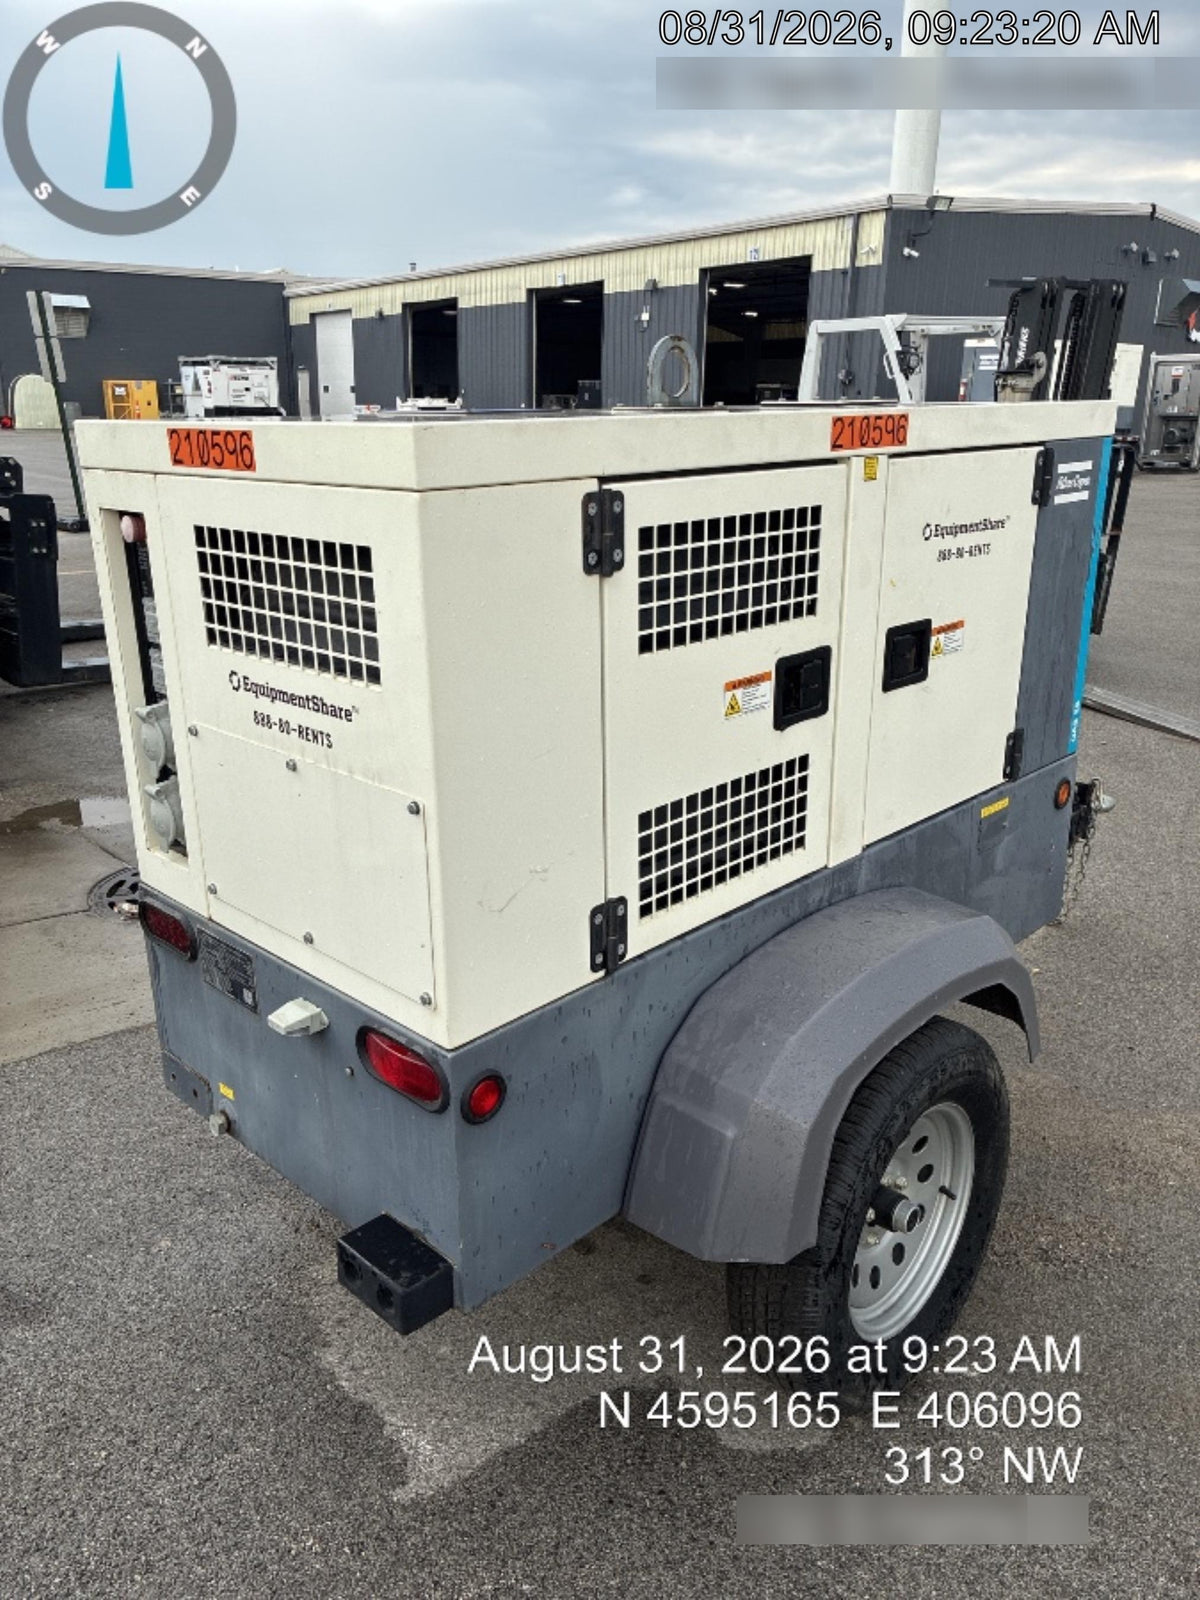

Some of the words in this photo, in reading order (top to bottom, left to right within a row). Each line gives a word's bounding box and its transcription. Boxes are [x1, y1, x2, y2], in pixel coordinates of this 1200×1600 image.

[168, 427, 254, 470] 210596
[832, 413, 908, 448] 210596
[242, 675, 353, 722] EquipmentShare
